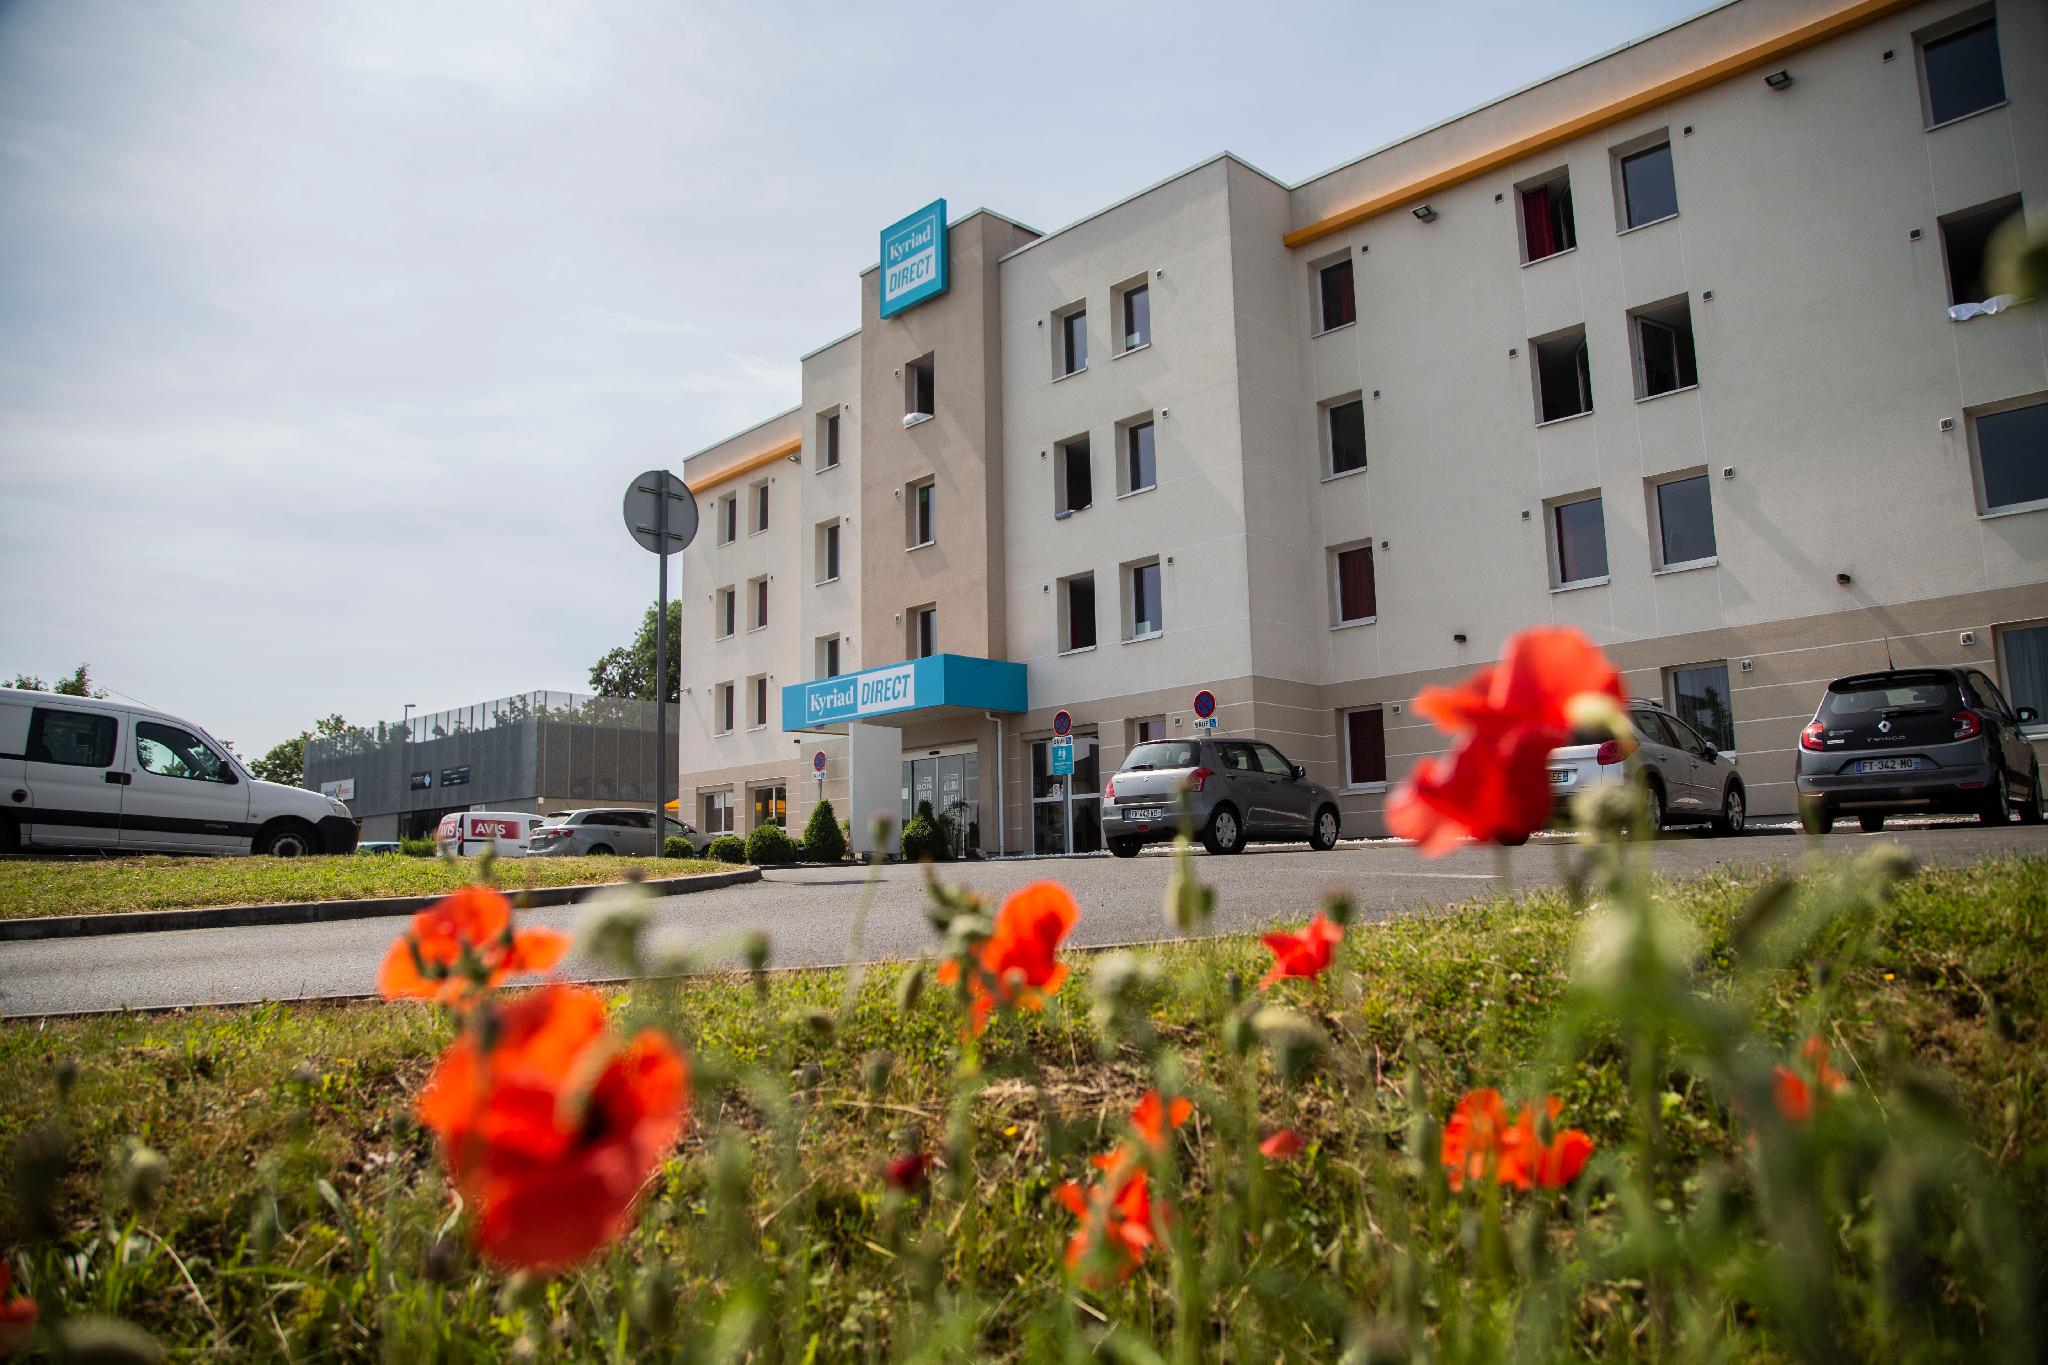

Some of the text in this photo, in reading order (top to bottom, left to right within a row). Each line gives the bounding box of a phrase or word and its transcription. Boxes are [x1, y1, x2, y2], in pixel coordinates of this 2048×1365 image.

[890, 224, 931, 262] Kyriad
[889, 255, 932, 292] DIRECT
[810, 674, 911, 716] Kyriad DIRECT
[1194, 720, 1209, 729] SAUF
[1867, 735, 1906, 743] TWINGO
[440, 822, 455, 837] AVIS
[475, 823, 506, 835] AVIS
